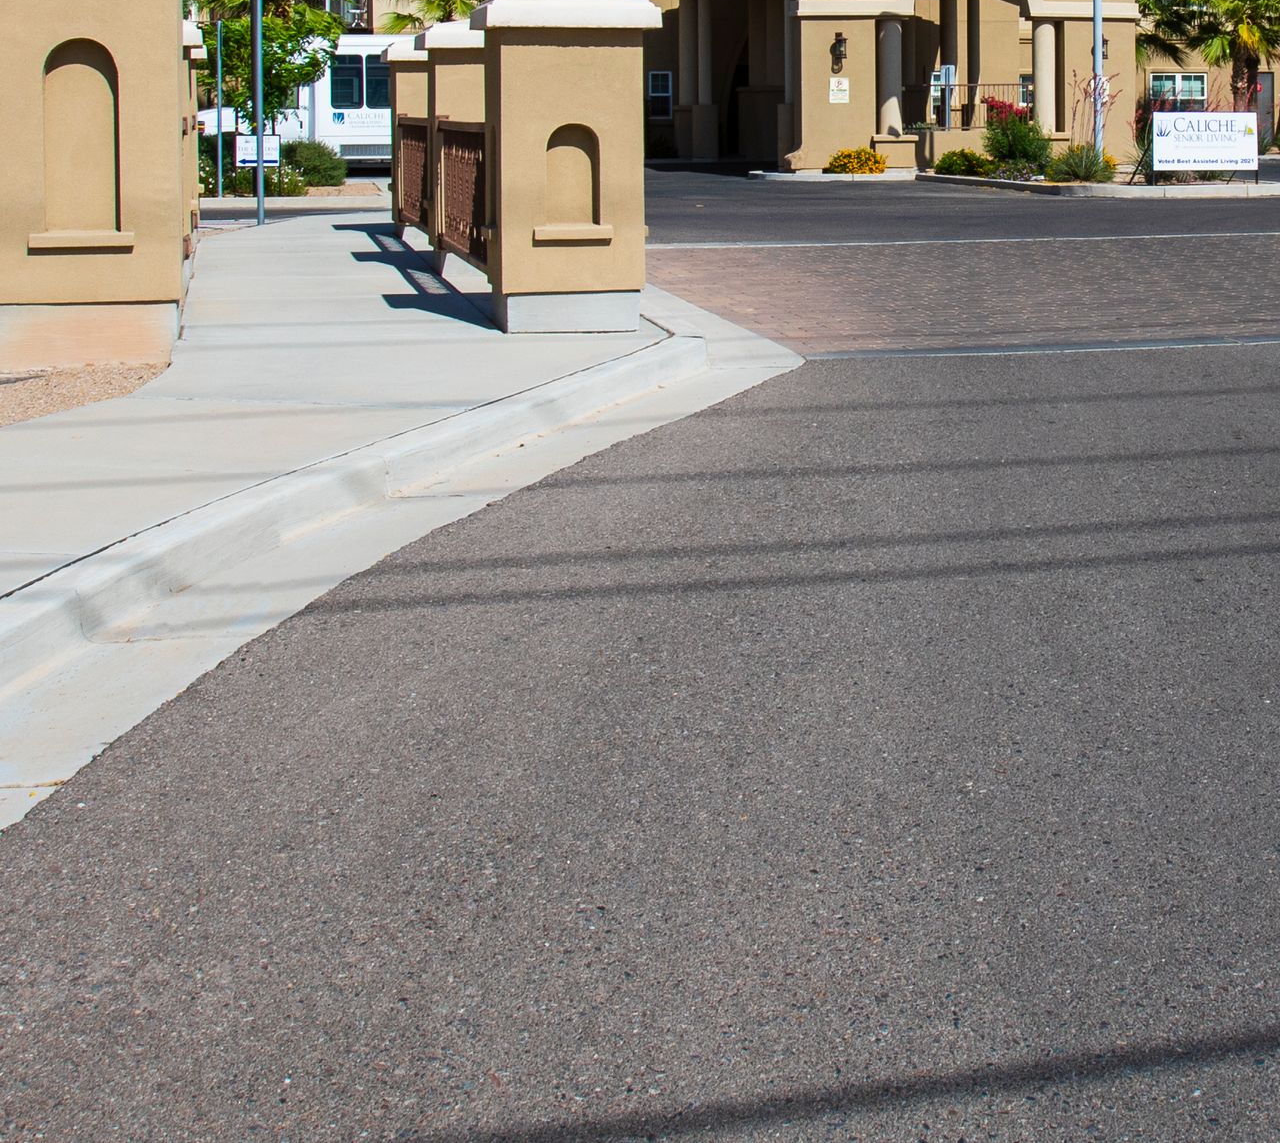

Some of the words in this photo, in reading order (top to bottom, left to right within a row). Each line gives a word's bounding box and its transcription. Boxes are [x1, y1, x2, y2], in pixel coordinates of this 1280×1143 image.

[1173, 117, 1237, 133] CALICHE
[1173, 133, 1203, 142] SENIOR
[1206, 133, 1237, 142] LIVING
